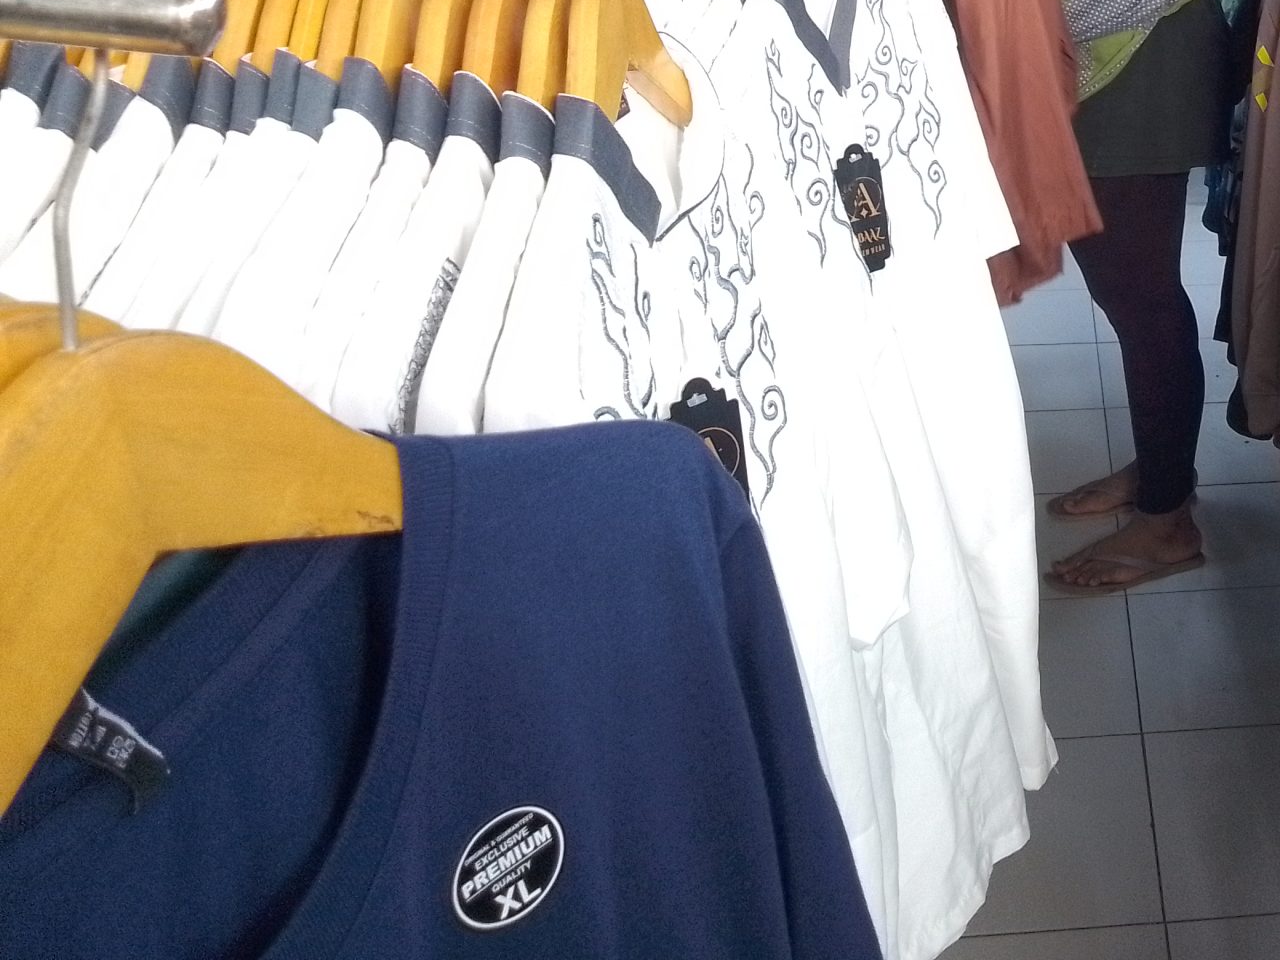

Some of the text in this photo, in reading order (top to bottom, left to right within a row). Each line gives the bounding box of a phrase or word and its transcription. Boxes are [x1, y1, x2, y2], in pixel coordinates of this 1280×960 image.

[460, 823, 553, 901] PREMIUM
[474, 825, 531, 871] EXCLUSIVE
[491, 859, 533, 894] QUALITY
[493, 878, 543, 921] XL
